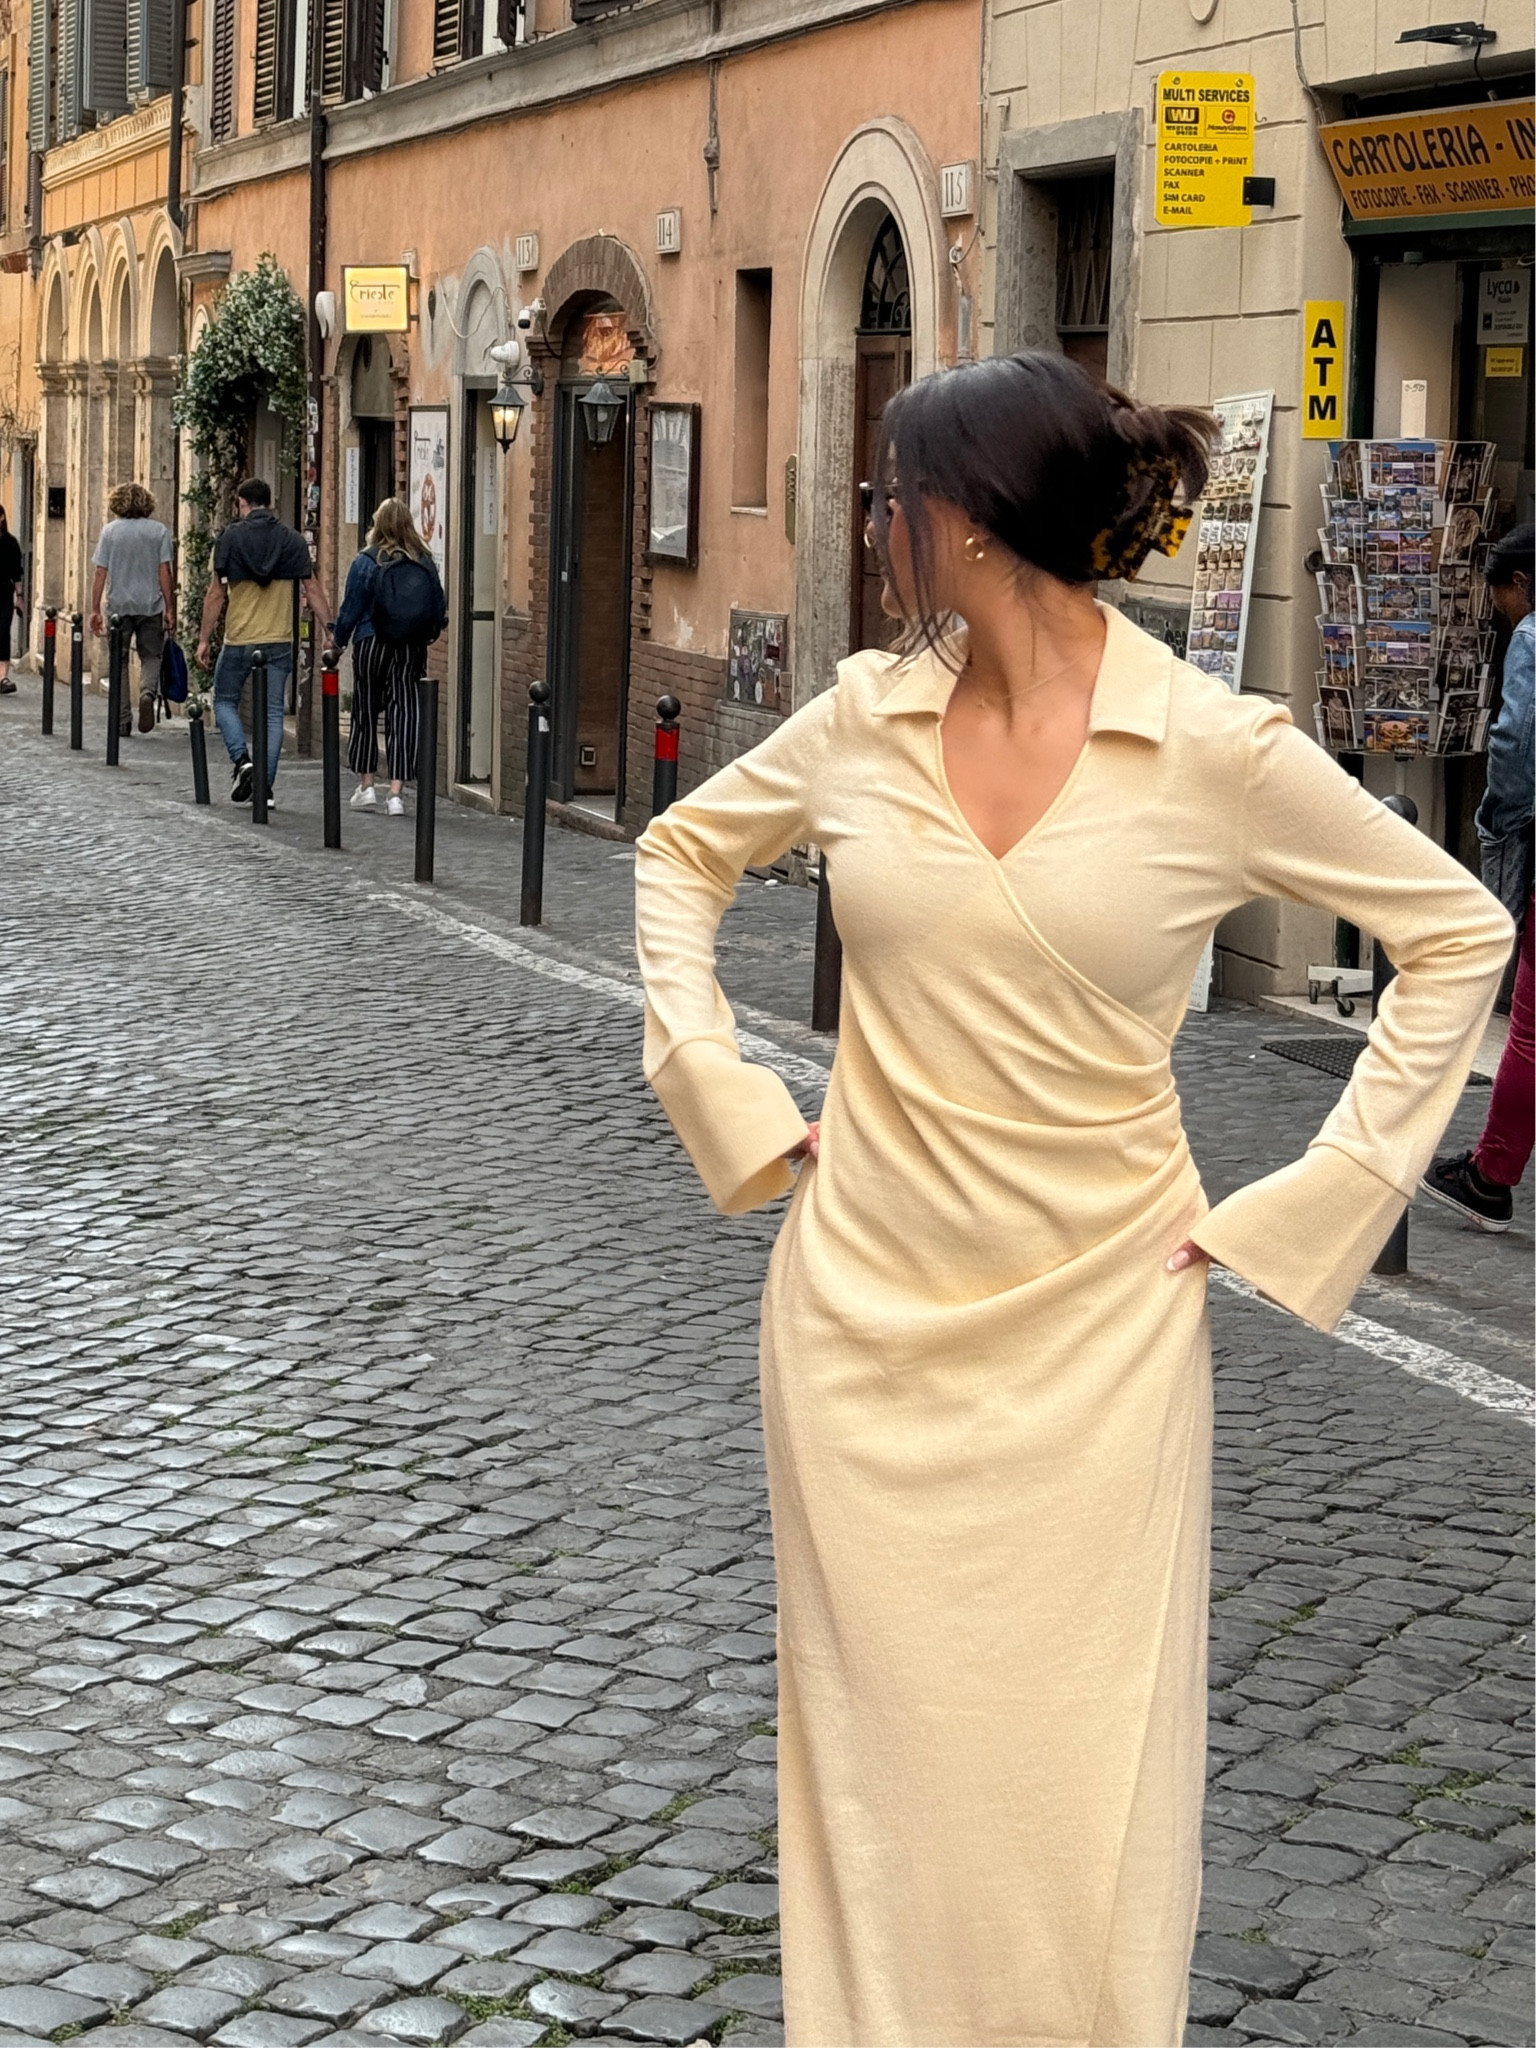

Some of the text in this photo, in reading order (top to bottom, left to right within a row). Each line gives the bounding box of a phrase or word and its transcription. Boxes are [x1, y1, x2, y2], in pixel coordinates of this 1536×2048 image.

[1163, 88, 1250, 102] MULTI SERVICES
[1170, 108, 1196, 122] WU
[1164, 143, 1218, 152] CARTOLERIA
[1332, 124, 1491, 177] CARTOLERIA
[1164, 155, 1213, 165] FOTOCOPIE
[1222, 157, 1248, 165] PRINT
[1163, 168, 1205, 177] SCANNER
[945, 171, 963, 207] 115
[1163, 181, 1180, 190] FAX
[1163, 194, 1206, 202] SIM CARD
[1350, 185, 1413, 209] FOTOCOPIE
[1416, 183, 1442, 205] FAX
[1445, 178, 1505, 203] SCANNER
[1163, 206, 1193, 215] E-MAIL
[658, 217, 672, 247] 114
[518, 239, 532, 265] 113
[1487, 278, 1513, 298] Lyca
[1308, 318, 1337, 421] ATM
